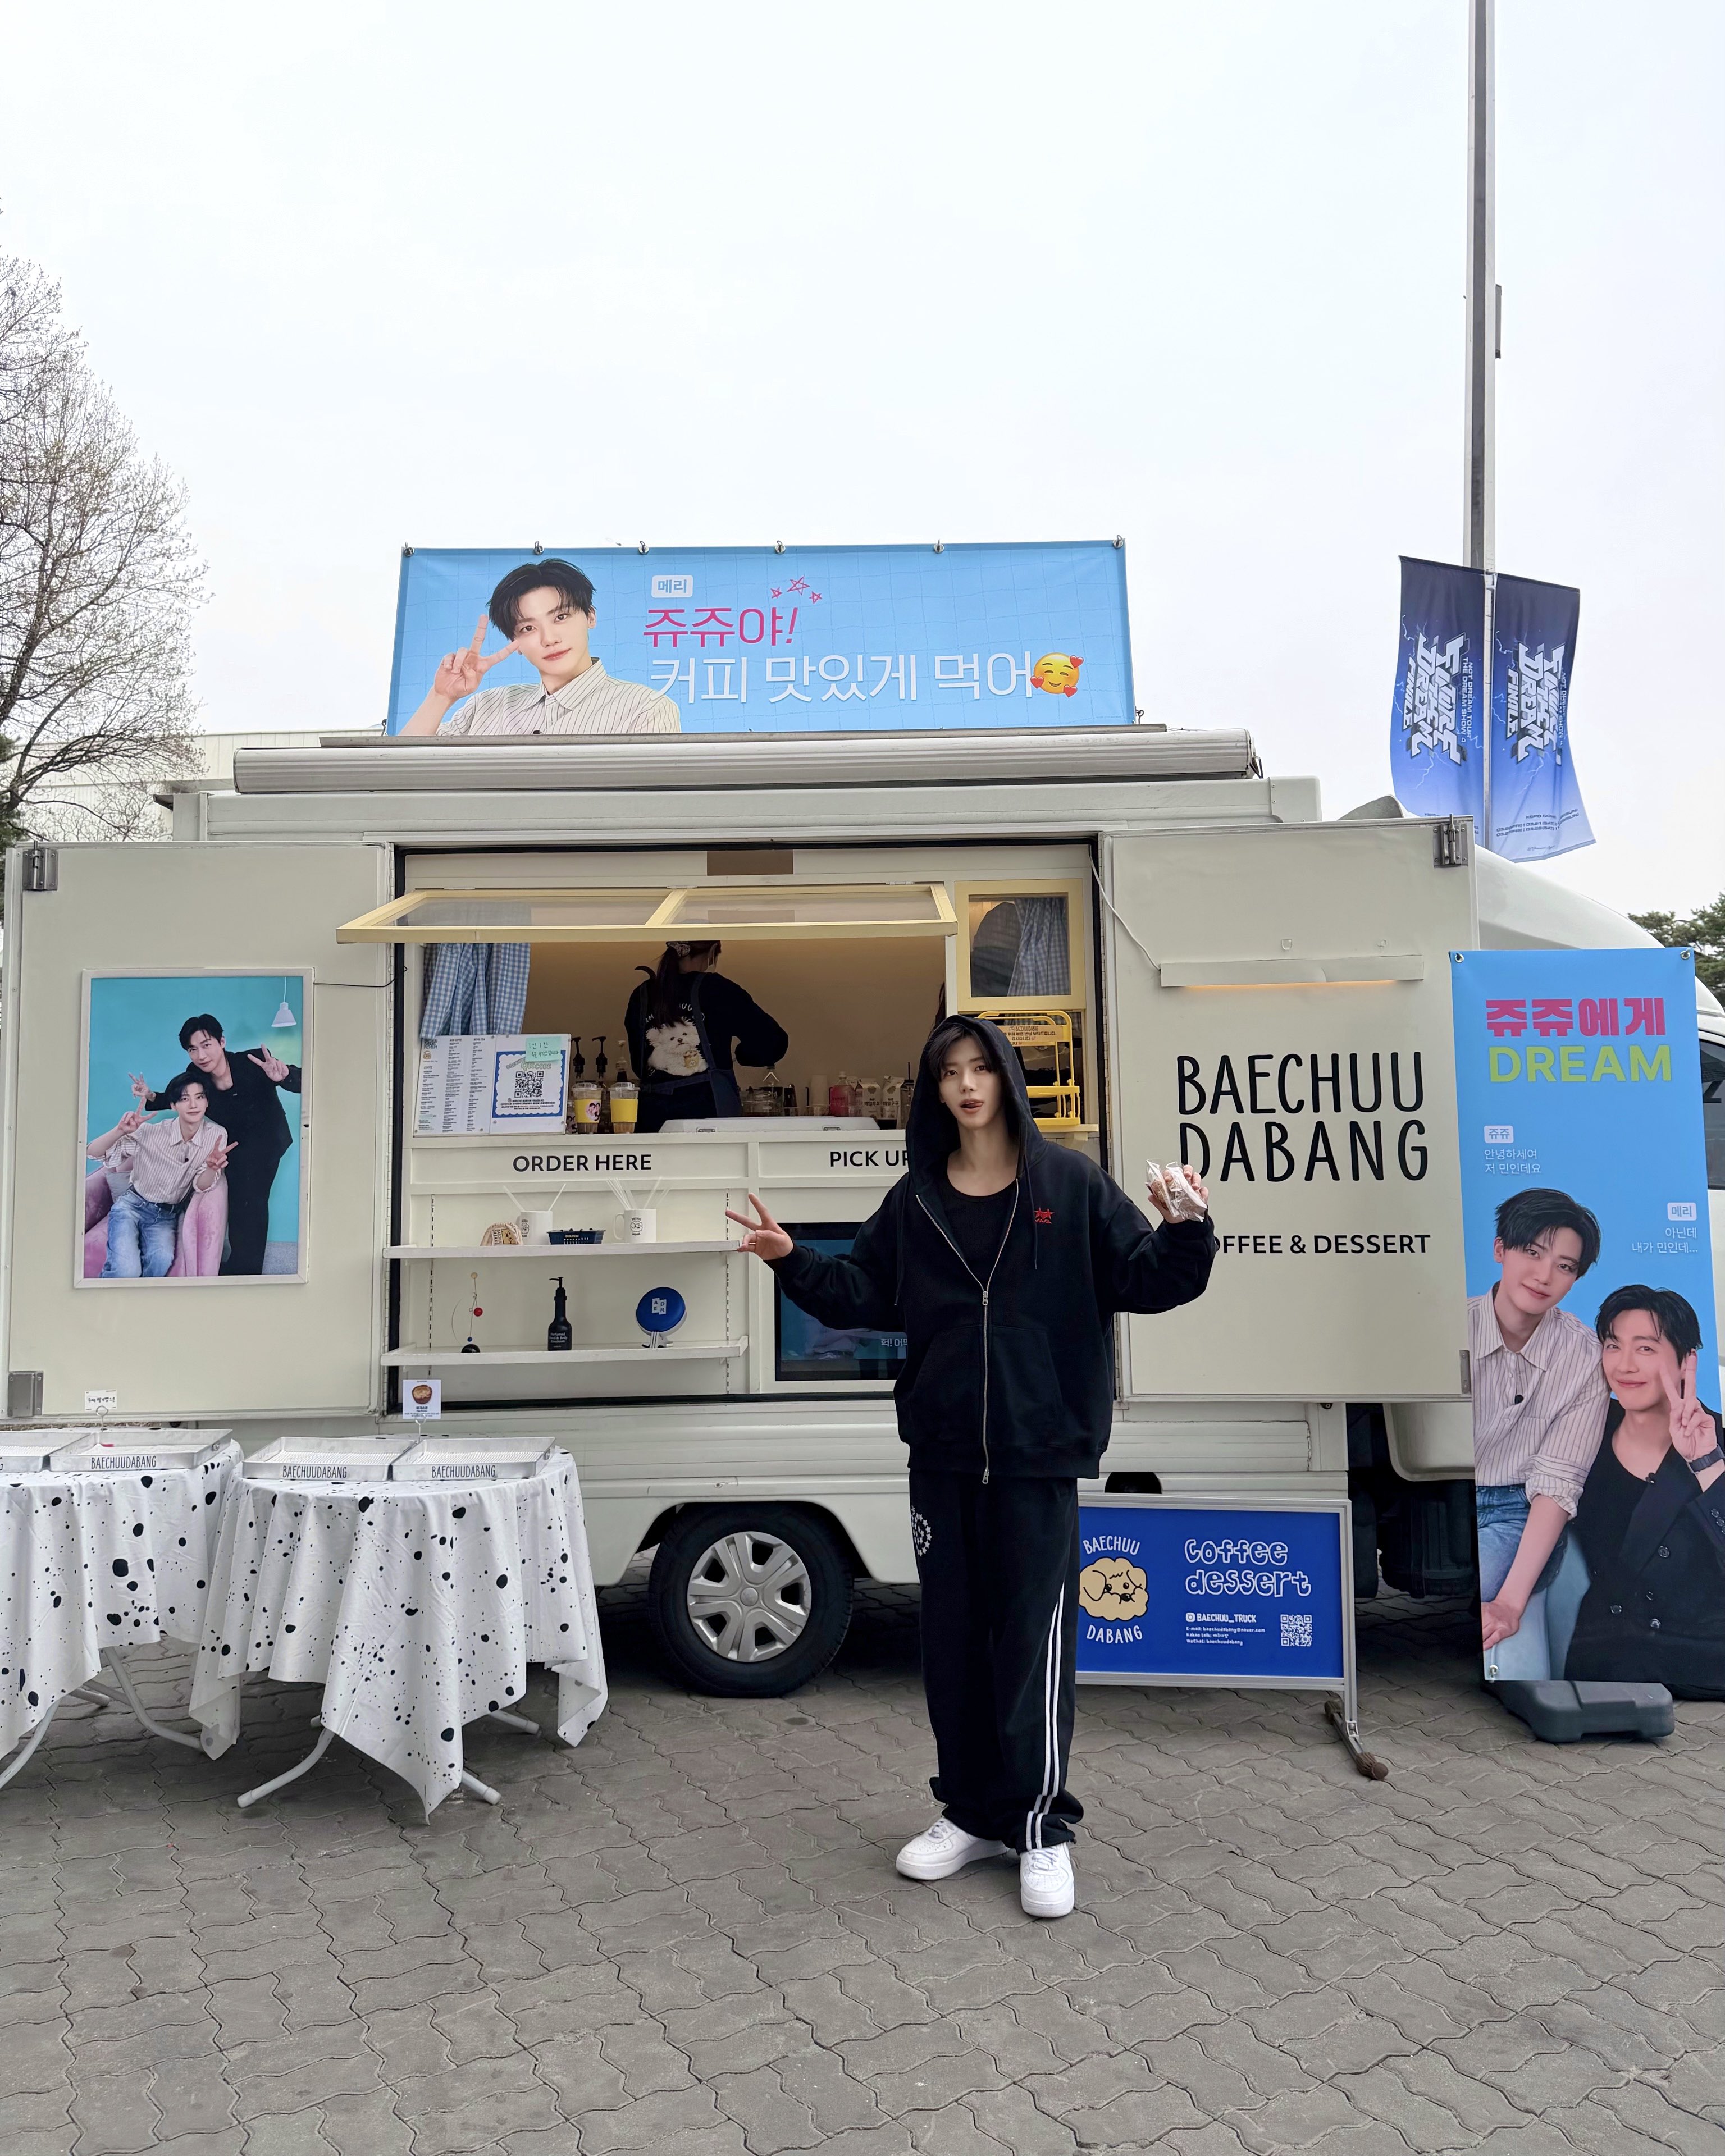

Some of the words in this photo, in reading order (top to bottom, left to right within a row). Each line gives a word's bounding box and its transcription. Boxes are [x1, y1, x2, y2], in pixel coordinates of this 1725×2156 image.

[658, 578, 687, 595] 메리
[644, 607, 798, 648] 쥬쥬야!
[650, 656, 748, 705] 커피
[765, 654, 918, 704] 맛있게
[934, 651, 1033, 701] 먹어
[1403, 656, 1416, 730] FINALE
[1411, 632, 1438, 757] DREAM
[1518, 643, 1544, 762] DREAM
[1506, 668, 1518, 739] FINALE
[1486, 997, 1666, 1037] 쥬쥬에게
[1489, 1045, 1672, 1082] DREAM
[1177, 1051, 1424, 1115] BAECHUU
[1488, 1128, 1510, 1140] 쥬쥬
[830, 1150, 879, 1167] PICK
[1179, 1119, 1428, 1182] DABANG
[1484, 1149, 1538, 1161] 안녕하세여
[513, 1155, 588, 1172] ORDER
[595, 1154, 652, 1171] HERE
[1485, 1164, 1496, 1175] 저
[1499, 1163, 1542, 1175] 민인데요
[1671, 1205, 1692, 1218] 메리
[1665, 1227, 1697, 1239] 아닌데
[1214, 1235, 1283, 1254] FFEE
[1290, 1235, 1307, 1254] &
[1313, 1234, 1431, 1254] DESSERT
[1632, 1242, 1654, 1254] 내가
[91, 1455, 157, 1470] BAECHUUDABANG
[282, 1465, 347, 1479] BAECHUUDABANG
[431, 1465, 496, 1478] BAECHUUDABANG
[1083, 1535, 1140, 1556] BAECHUU
[1184, 1539, 1288, 1566] Coffee
[1185, 1570, 1312, 1598] dessert
[1197, 1613, 1257, 1624] BAECHUU_TRUCK
[1086, 1624, 1143, 1644] DABANG
